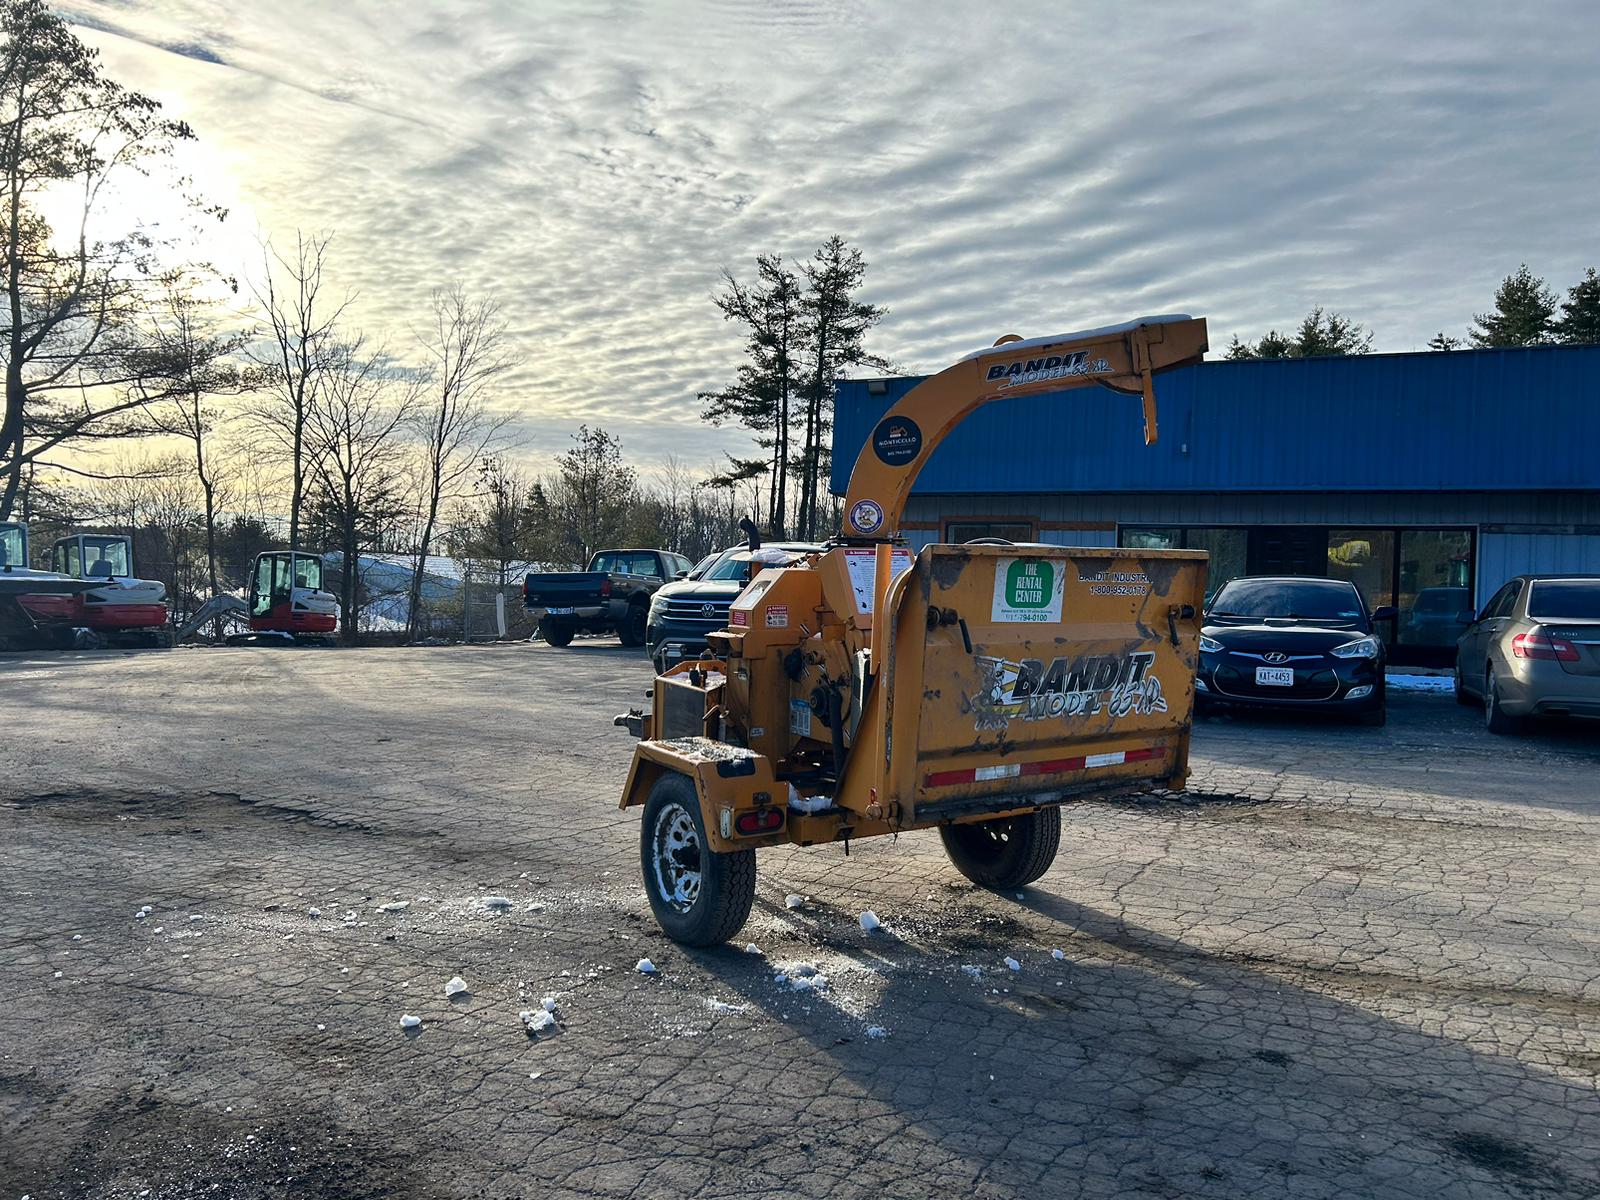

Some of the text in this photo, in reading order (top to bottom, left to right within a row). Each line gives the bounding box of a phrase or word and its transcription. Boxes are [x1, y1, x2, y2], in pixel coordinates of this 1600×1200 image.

[987, 351, 1089, 380] BANDIT
[1025, 563, 1038, 576] THE
[1016, 576, 1043, 590] RENTAL
[1015, 590, 1042, 603] CENTER
[1011, 652, 1155, 699] BANDIT
